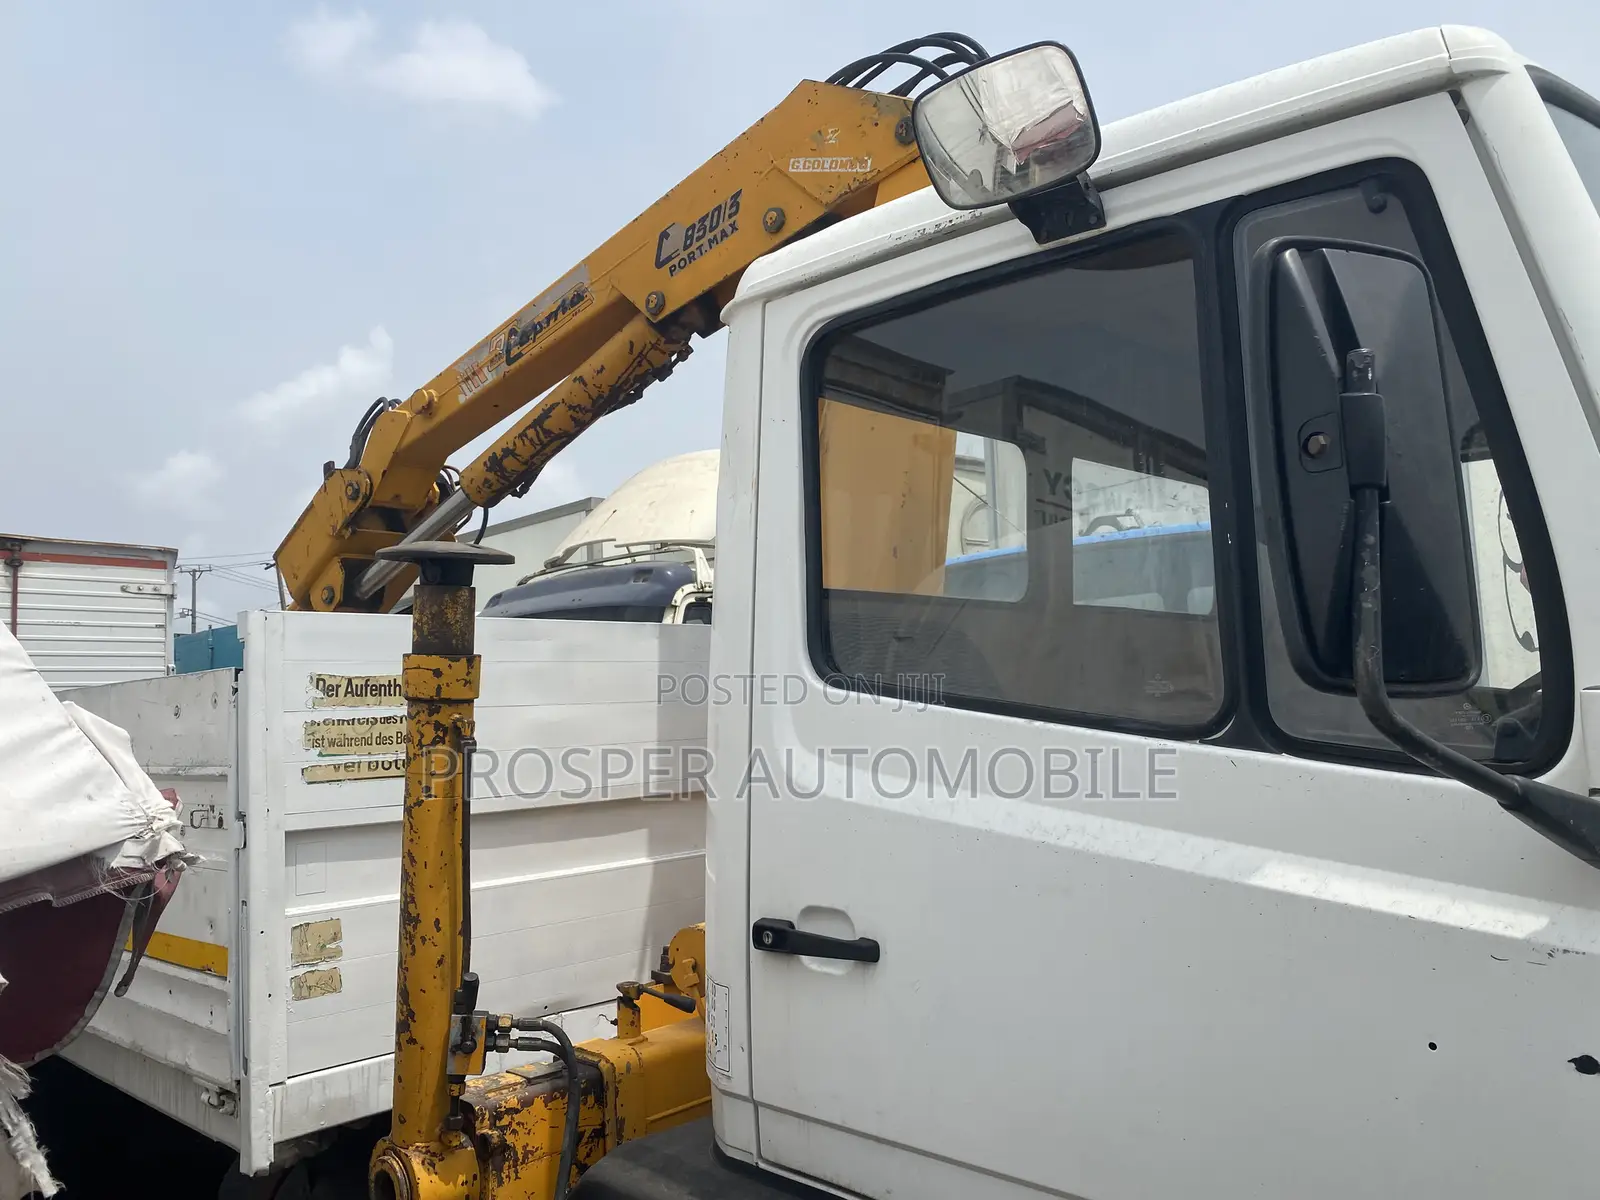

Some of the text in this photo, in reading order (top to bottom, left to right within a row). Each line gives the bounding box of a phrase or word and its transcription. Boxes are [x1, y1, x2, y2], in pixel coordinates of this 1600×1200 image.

[683, 188, 743, 251] 830/3
[668, 220, 739, 277] PORT.MAX
[316, 678, 341, 697] Der
[327, 733, 373, 748] während
[375, 732, 394, 746] des
